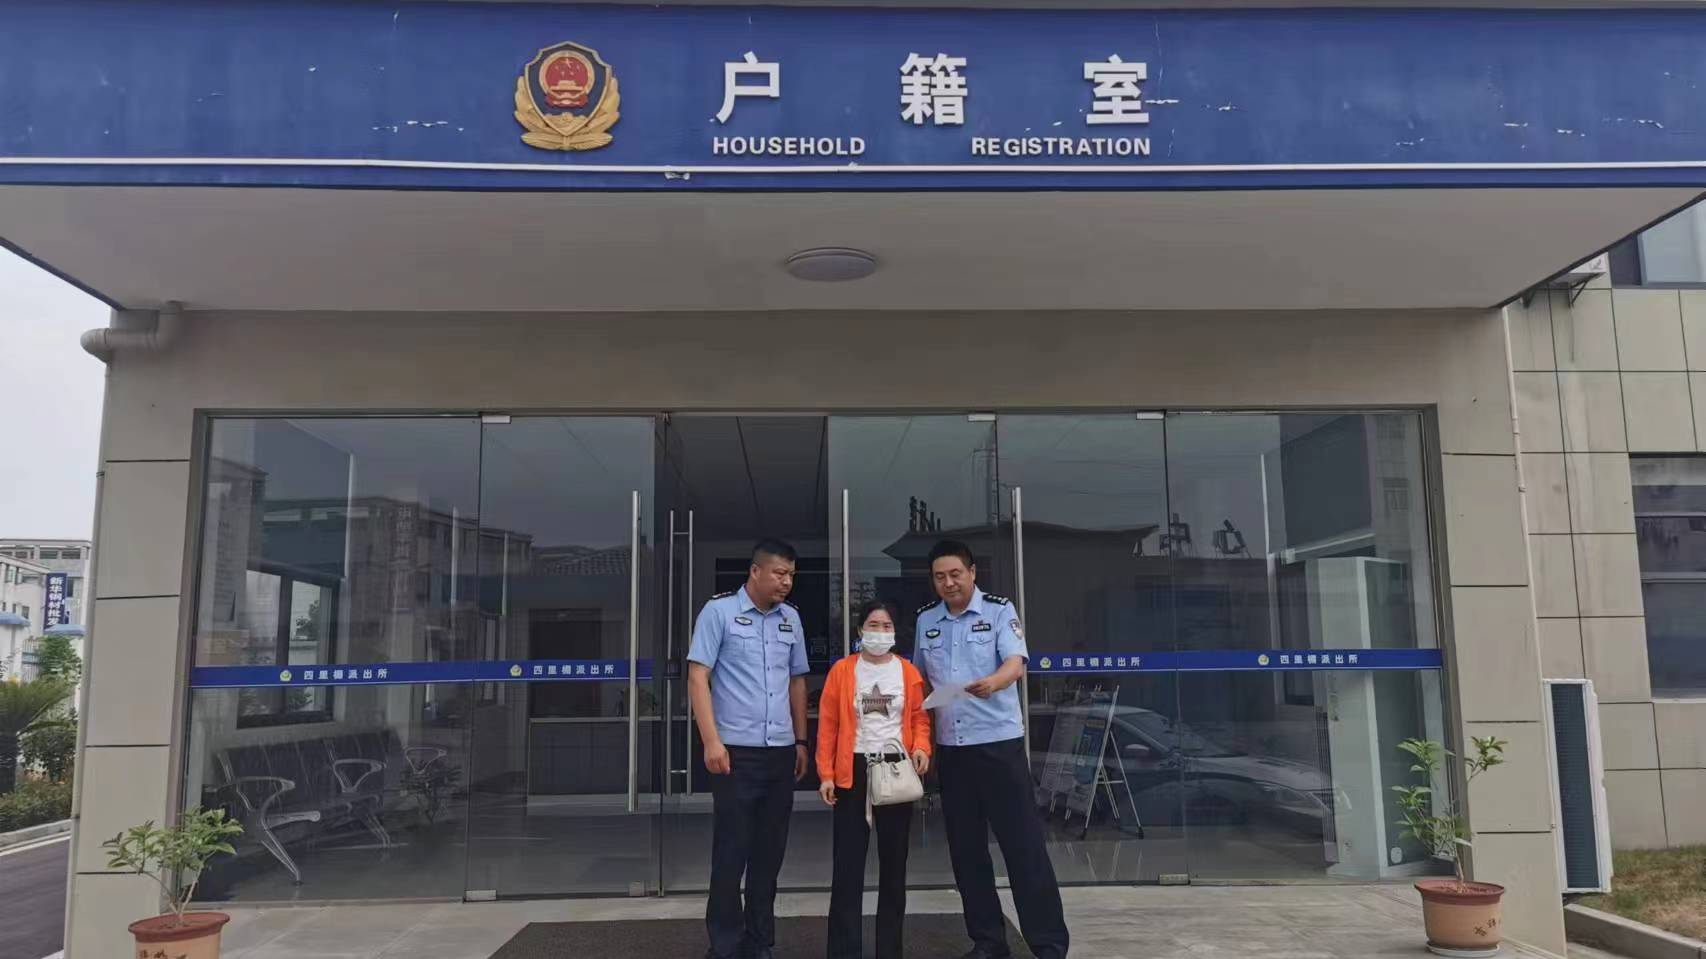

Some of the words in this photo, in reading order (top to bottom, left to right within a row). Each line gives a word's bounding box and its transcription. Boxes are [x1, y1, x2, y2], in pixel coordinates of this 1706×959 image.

[715, 50, 1150, 125] 户籍室
[713, 136, 866, 156] HOUSEHOLD
[971, 137, 1152, 156] REGISTRATION
